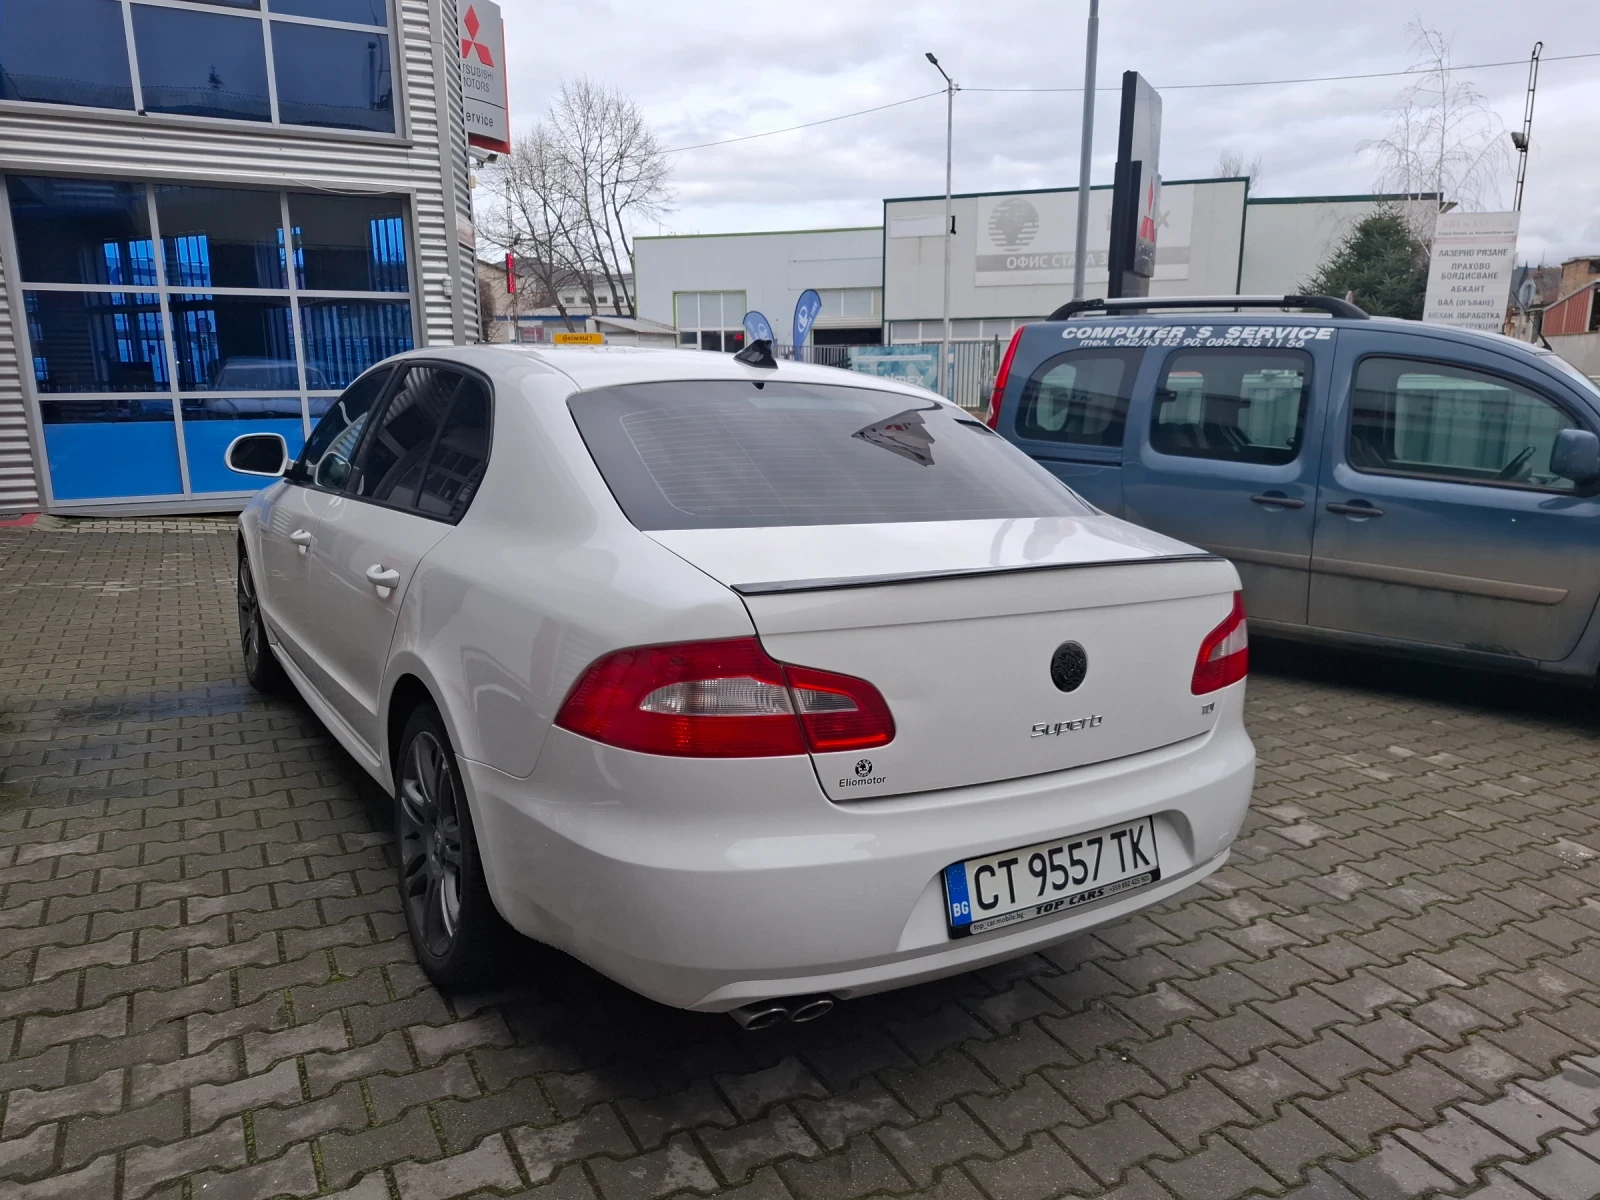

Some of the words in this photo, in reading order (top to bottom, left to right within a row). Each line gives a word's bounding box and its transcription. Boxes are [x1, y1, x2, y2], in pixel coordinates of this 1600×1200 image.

[462, 63, 494, 81] TSUBISHI
[465, 112, 494, 128] ervice
[1438, 249, 1475, 257] ЛАЗЕРНО
[1476, 248, 1508, 256] РЯЗАНЕ
[1006, 254, 1049, 269] ОФИС
[1051, 254, 1096, 268] СТАА
[1441, 272, 1499, 280] БОЯДИСВАНЕ
[1450, 285, 1486, 293] АБКАНТ
[1061, 325, 1187, 339] COMPUTER
[1225, 326, 1335, 340] SERVICE
[1162, 338, 1180, 347] 82
[1206, 337, 1241, 347] 0894
[1243, 338, 1261, 347] 35
[1286, 339, 1306, 348] 56
[1031, 714, 1103, 738] Superb
[839, 776, 887, 787] Eliomotor
[974, 857, 1019, 911] CT
[1028, 836, 1104, 897] 9557
[1110, 825, 1151, 873] TK
[1035, 899, 1064, 915] TOP
[1068, 887, 1105, 905] CARS
[953, 901, 970, 917] BG
